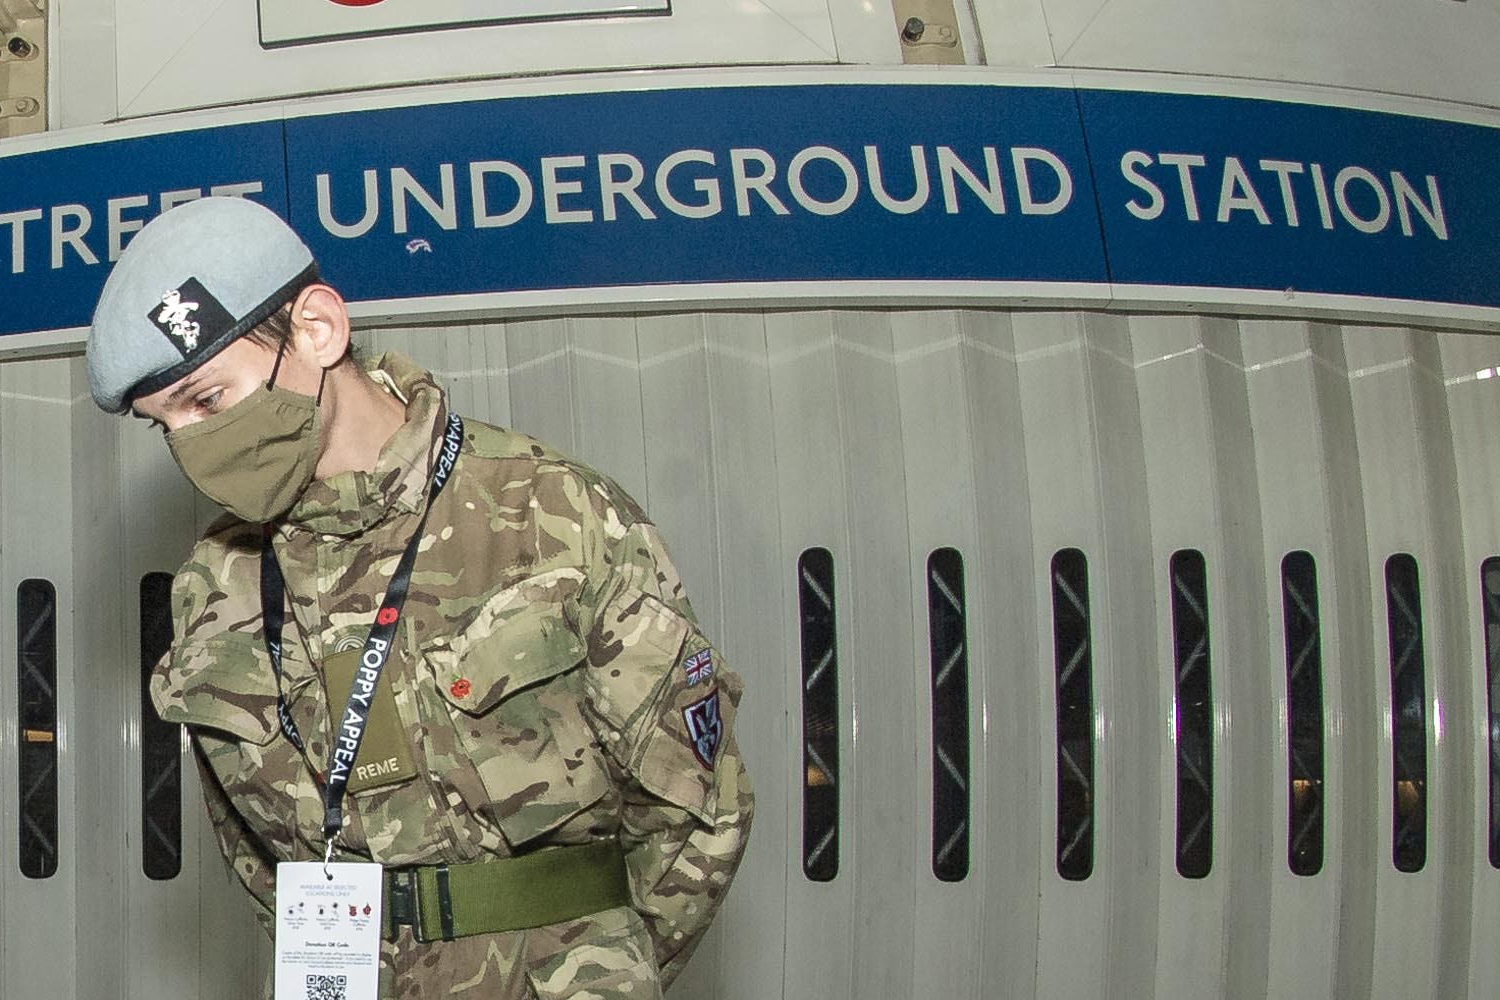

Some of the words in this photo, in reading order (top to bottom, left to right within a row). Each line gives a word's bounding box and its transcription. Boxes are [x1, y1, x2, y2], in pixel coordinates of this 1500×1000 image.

[317, 145, 1074, 239] UNDERGROUND
[1120, 150, 1449, 240] STATION
[434, 427, 461, 487] APPEAL
[352, 637, 388, 708] POPPY
[330, 707, 364, 784] APPEAL
[356, 757, 400, 782] REME
